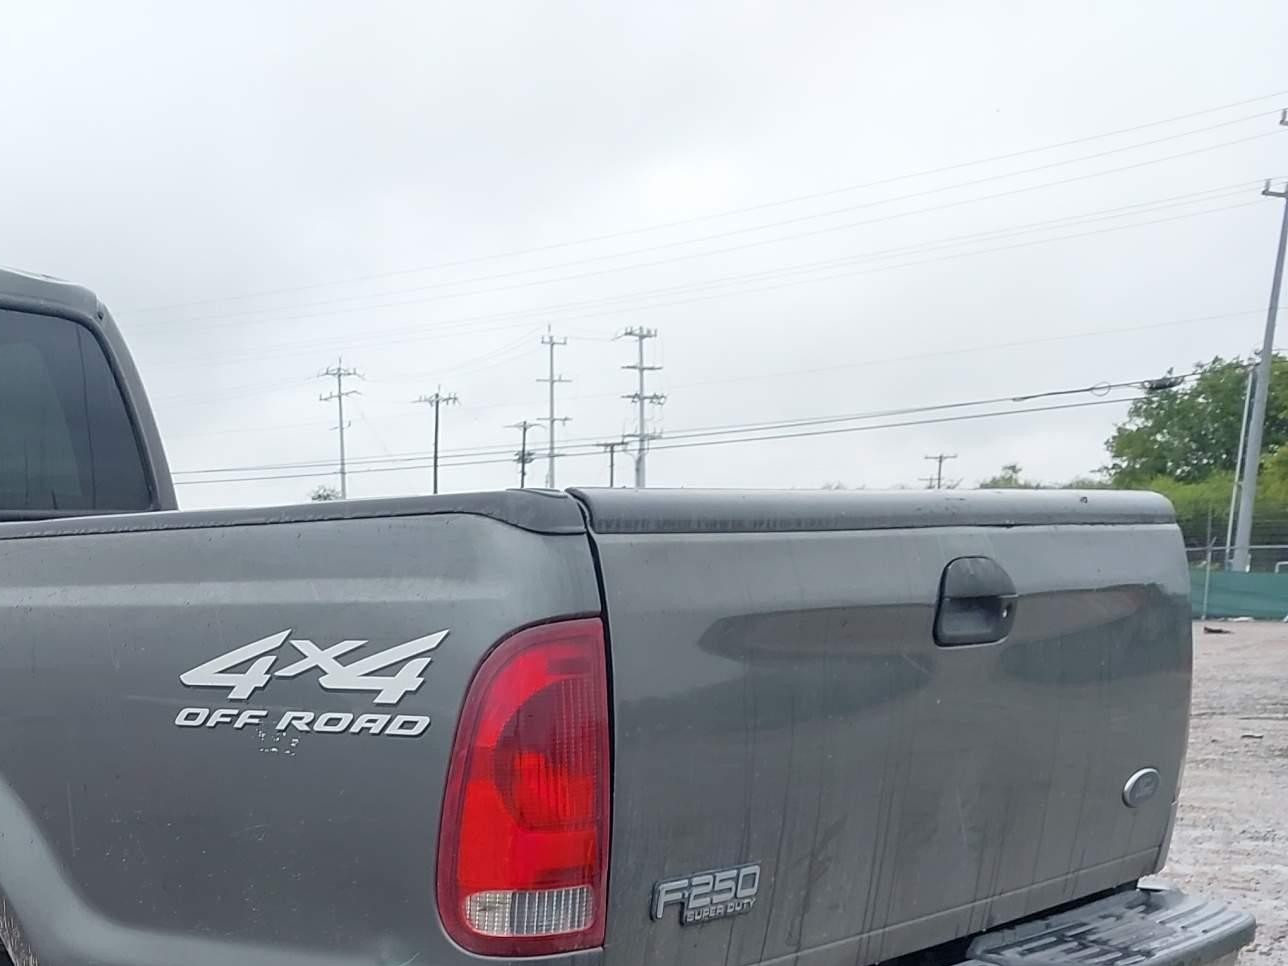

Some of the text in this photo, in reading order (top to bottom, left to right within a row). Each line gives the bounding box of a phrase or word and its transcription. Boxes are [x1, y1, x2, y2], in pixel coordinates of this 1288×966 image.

[174, 707, 431, 736] OFF ROAD
[686, 897, 757, 923] SUPER DUTY
